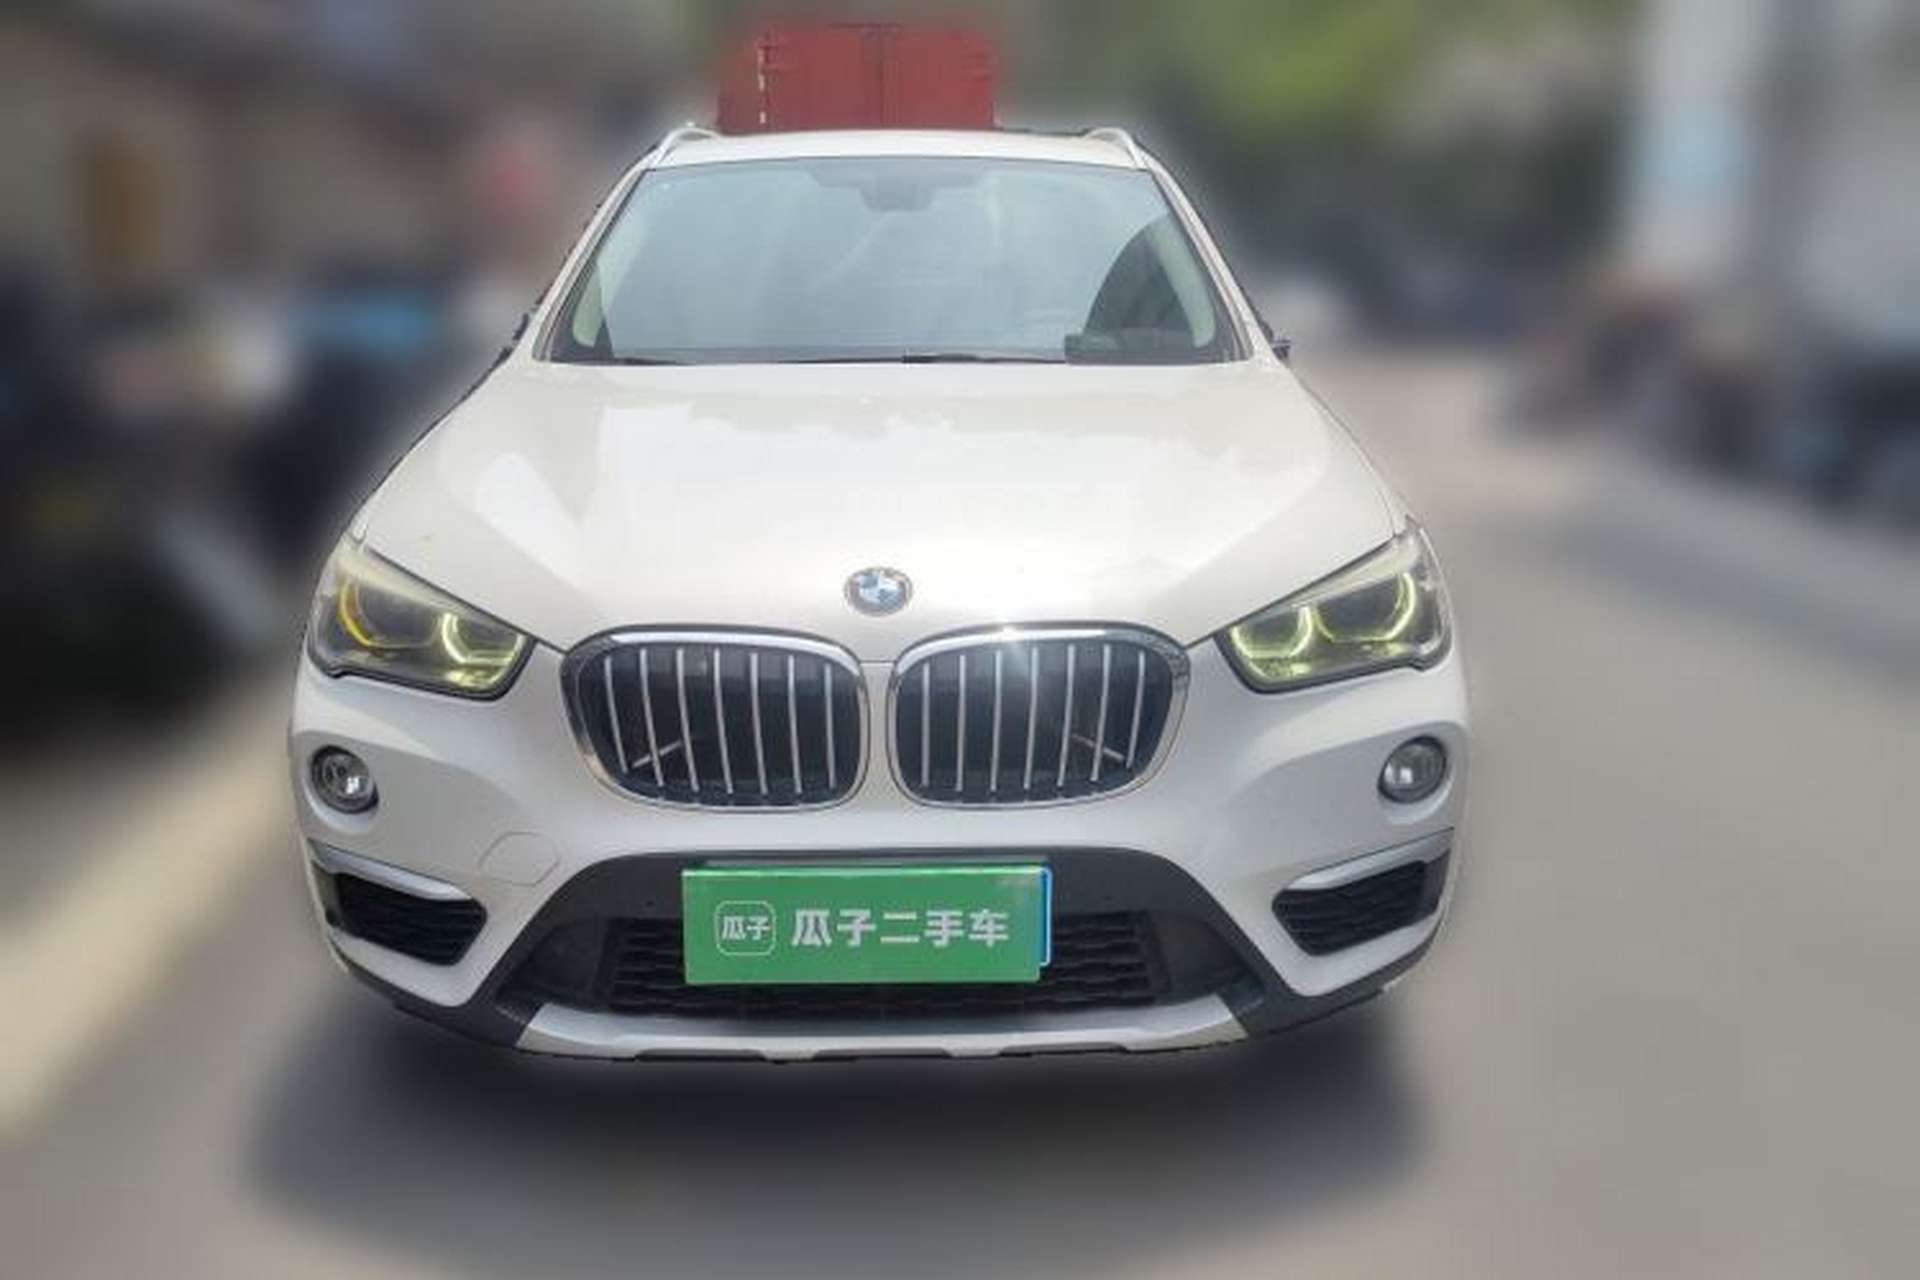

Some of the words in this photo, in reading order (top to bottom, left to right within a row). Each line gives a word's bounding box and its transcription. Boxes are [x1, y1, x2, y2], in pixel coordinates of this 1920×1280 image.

[721, 915, 770, 941] 瓜子
[791, 909, 1009, 948] 瓜子二手车
